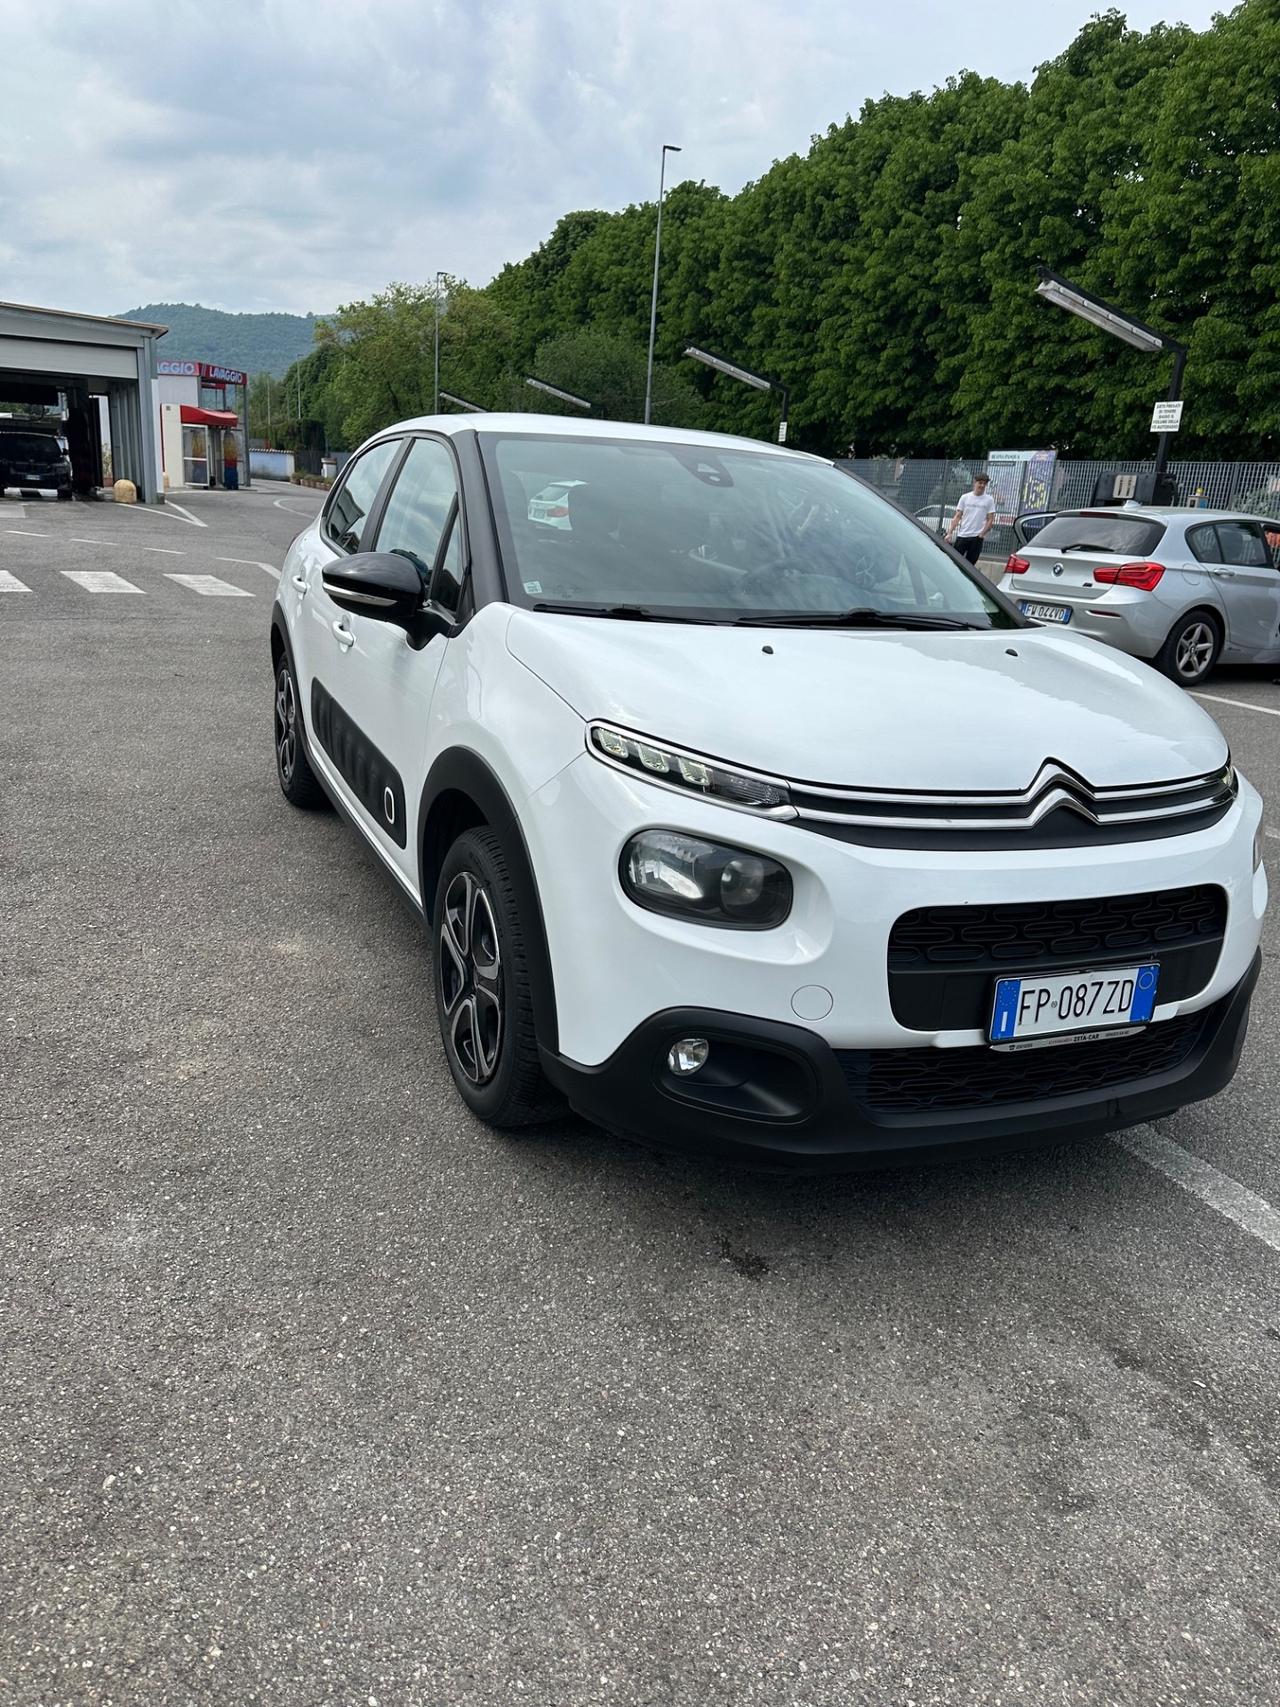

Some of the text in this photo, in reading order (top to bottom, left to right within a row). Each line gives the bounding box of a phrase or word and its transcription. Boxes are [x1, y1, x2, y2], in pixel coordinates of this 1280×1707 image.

[209, 366, 243, 383] LAVAGGIO
[1018, 979, 1134, 1026] FP 087ZD
[1073, 1033, 1100, 1042] ZETA-CAR
